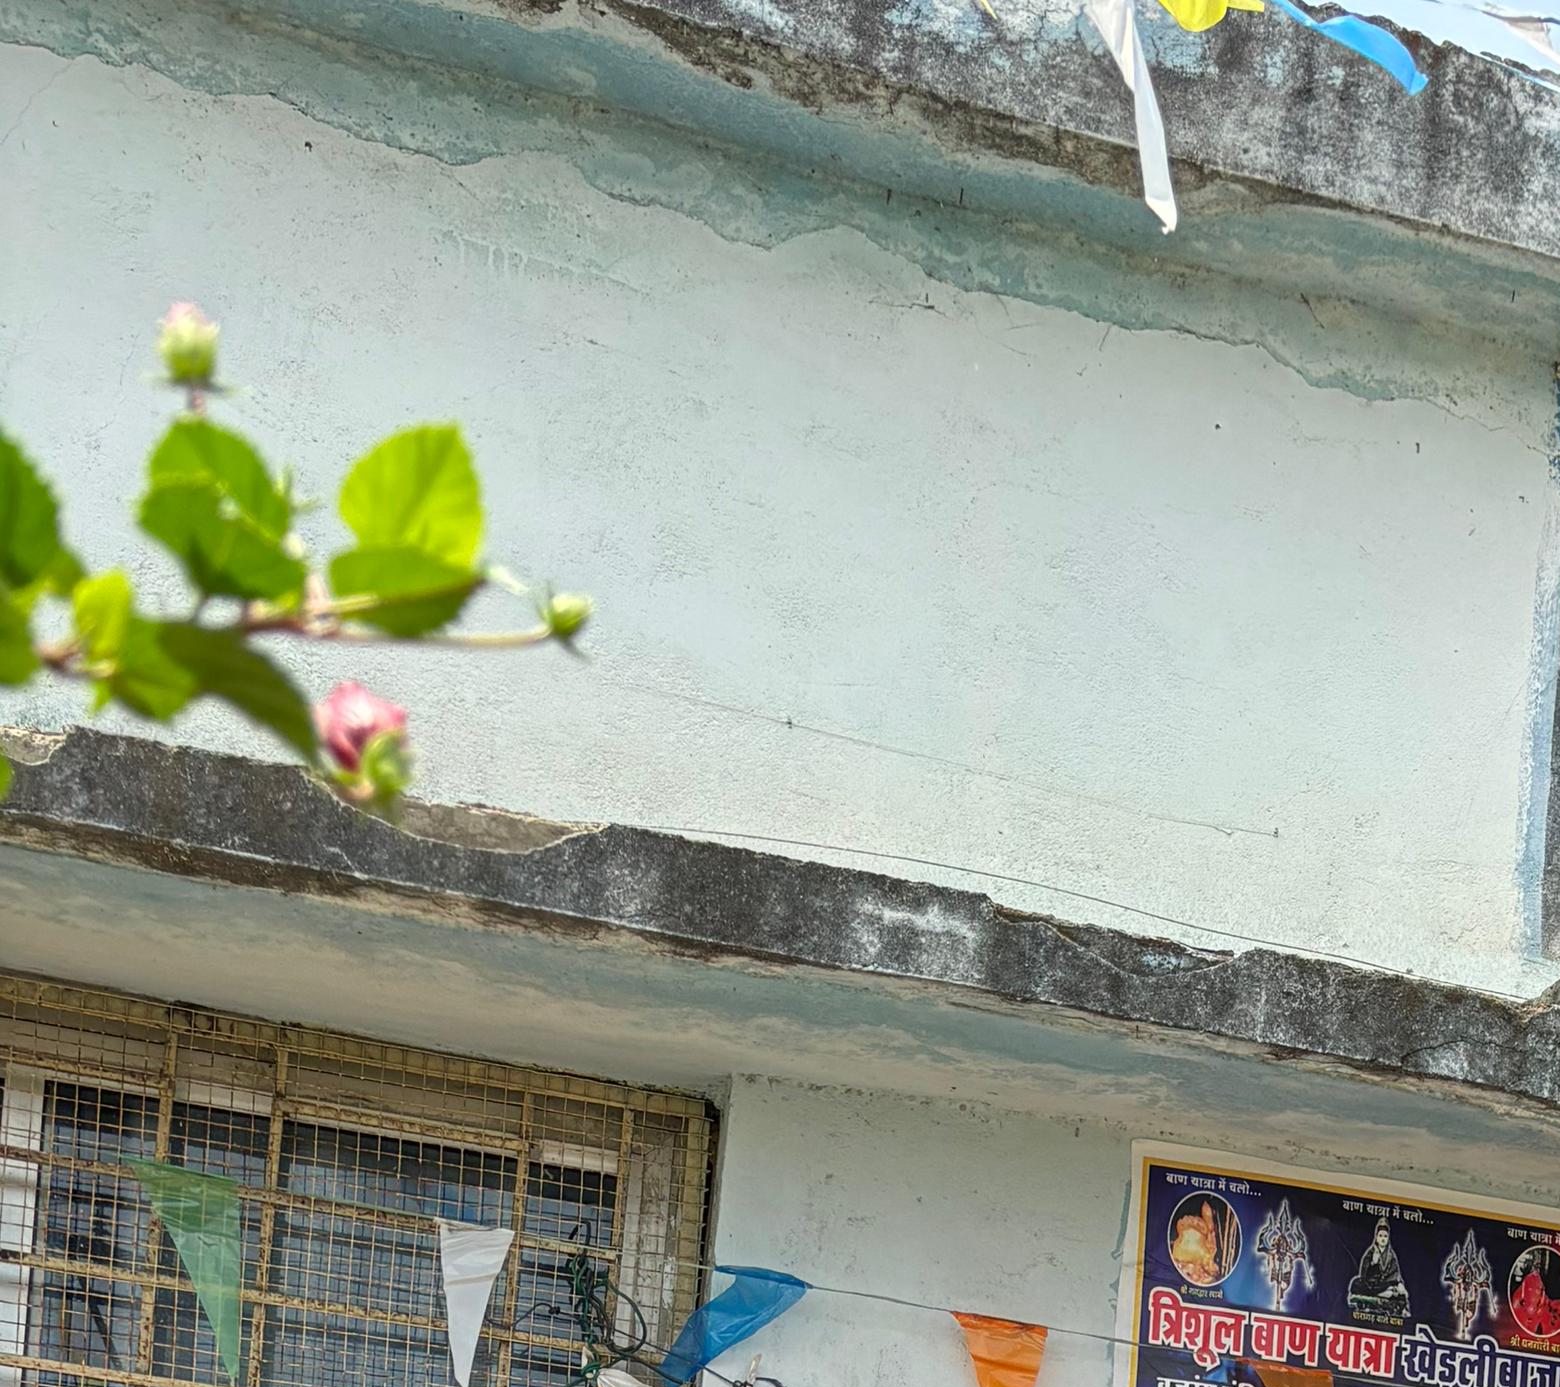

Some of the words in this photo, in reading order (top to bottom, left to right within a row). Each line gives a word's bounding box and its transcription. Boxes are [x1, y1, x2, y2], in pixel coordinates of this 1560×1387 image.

[1166, 1172, 1187, 1187] बाण
[1190, 1176, 1216, 1191] यात्रा
[1218, 1177, 1227, 1191] में
[1342, 1199, 1363, 1214] बाण
[1366, 1203, 1390, 1218] यात्रा
[1507, 1227, 1527, 1241] बाण
[1530, 1230, 1553, 1246] यात्रा
[1149, 1287, 1249, 1371] त्रिशूल
[1250, 1312, 1325, 1366] बाण
[1326, 1322, 1399, 1378] यात्रा
